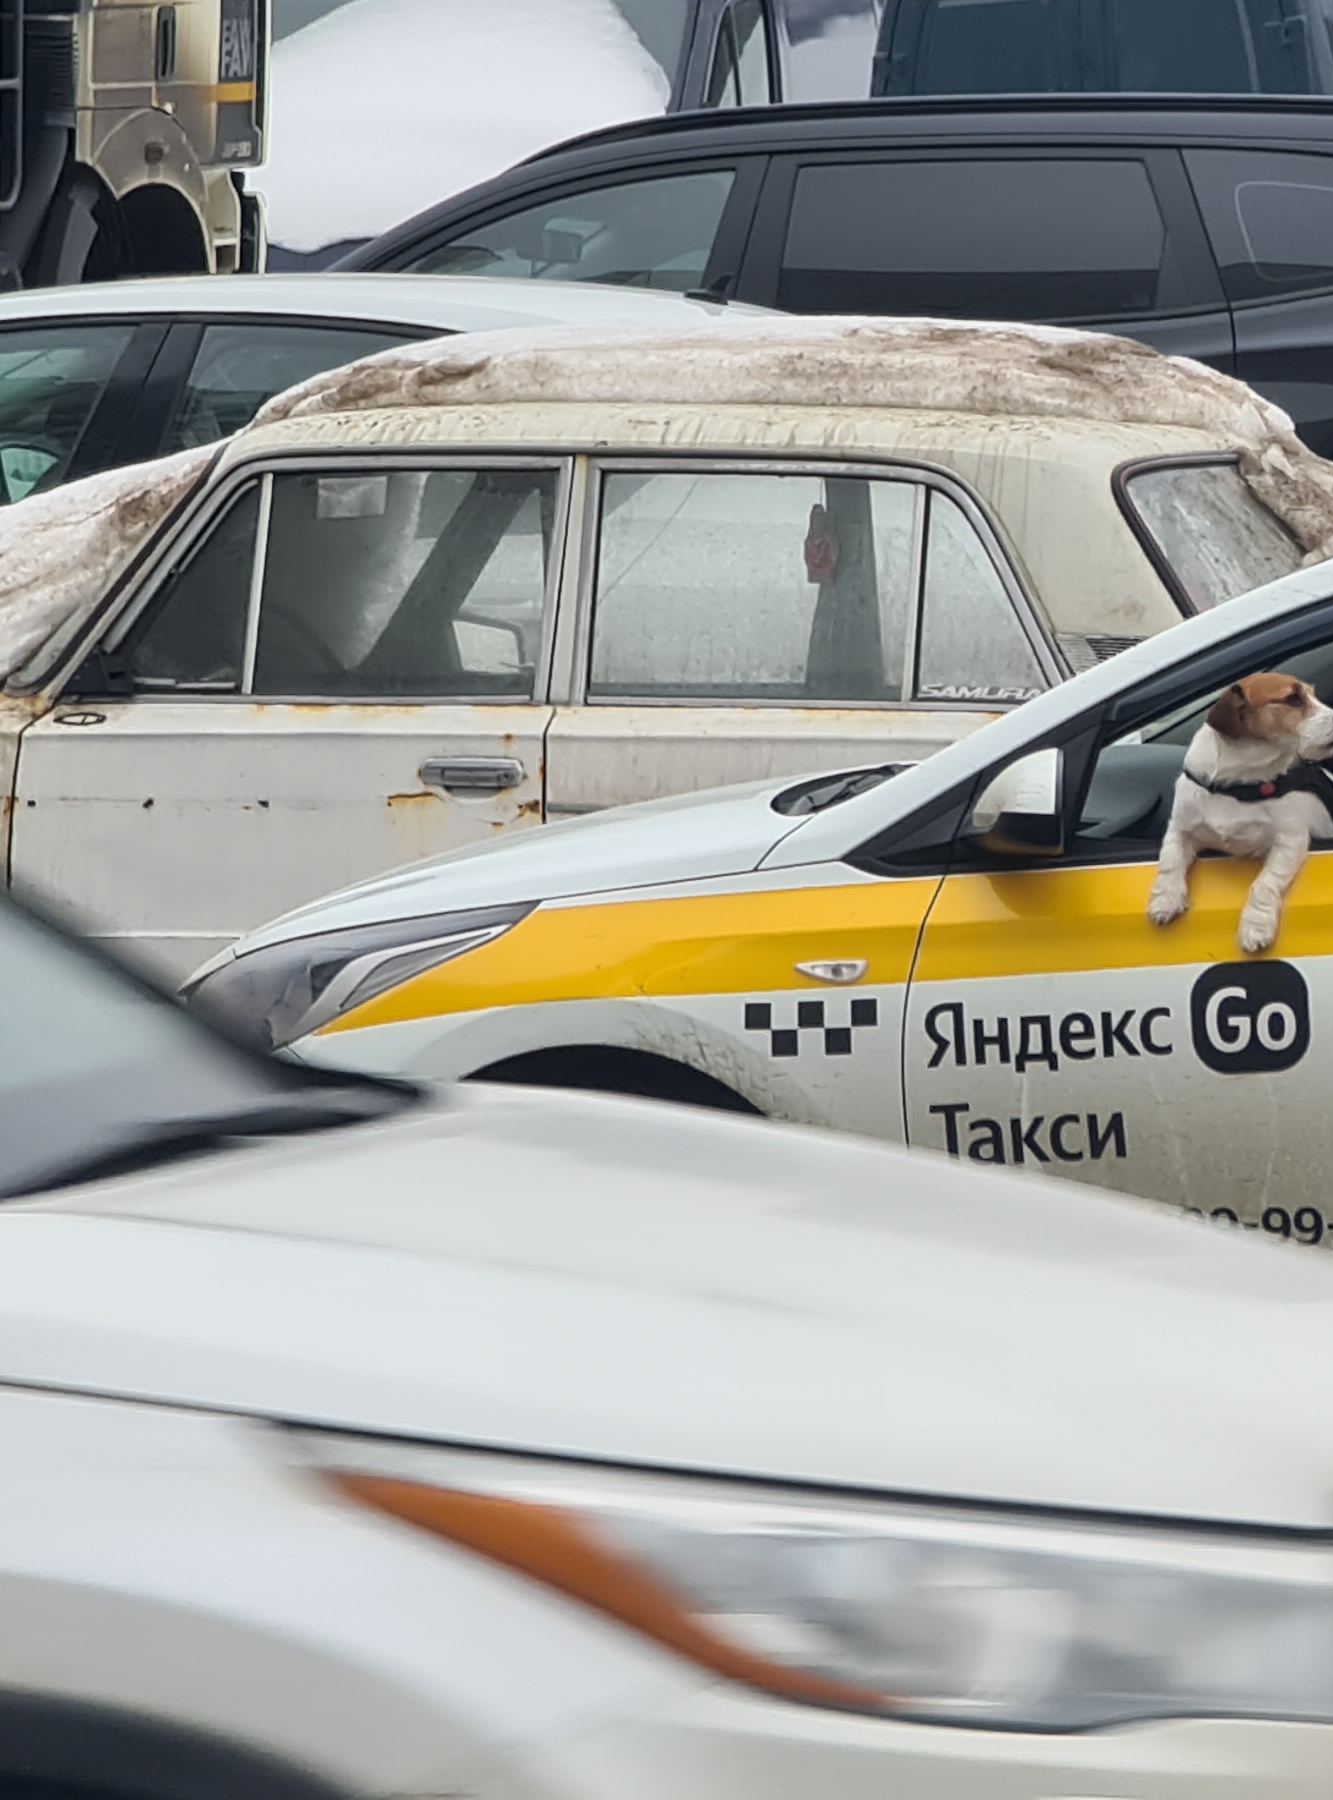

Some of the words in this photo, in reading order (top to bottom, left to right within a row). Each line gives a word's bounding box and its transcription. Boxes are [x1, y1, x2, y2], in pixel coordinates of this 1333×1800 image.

[924, 1002, 1173, 1073] Яндекс
[1205, 986, 1297, 1053] Go
[929, 1102, 1128, 1164] Такси
